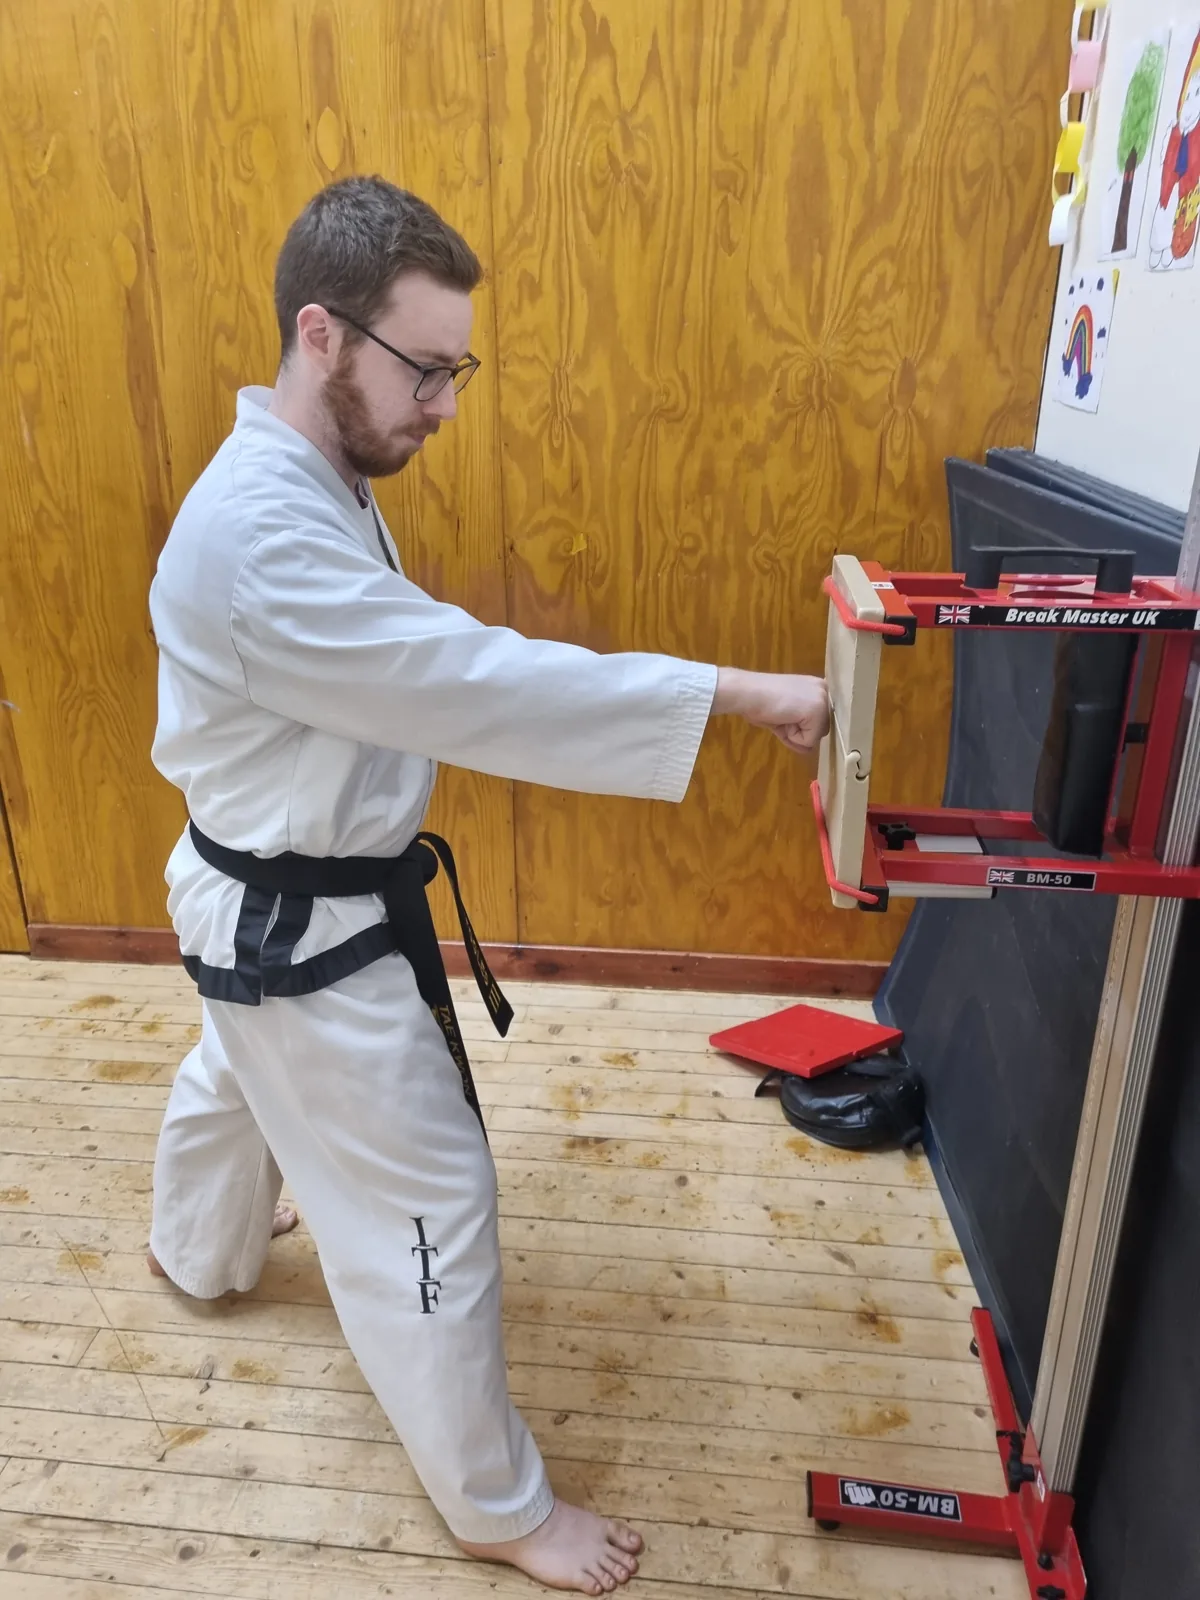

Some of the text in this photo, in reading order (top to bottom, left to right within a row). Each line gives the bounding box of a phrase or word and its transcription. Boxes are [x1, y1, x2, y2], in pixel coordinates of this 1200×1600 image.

[1005, 608, 1161, 627] Break Master UK
[1026, 873, 1072, 885] BM-50
[409, 1216, 442, 1315] ITF
[879, 1489, 956, 1516] BM-50
